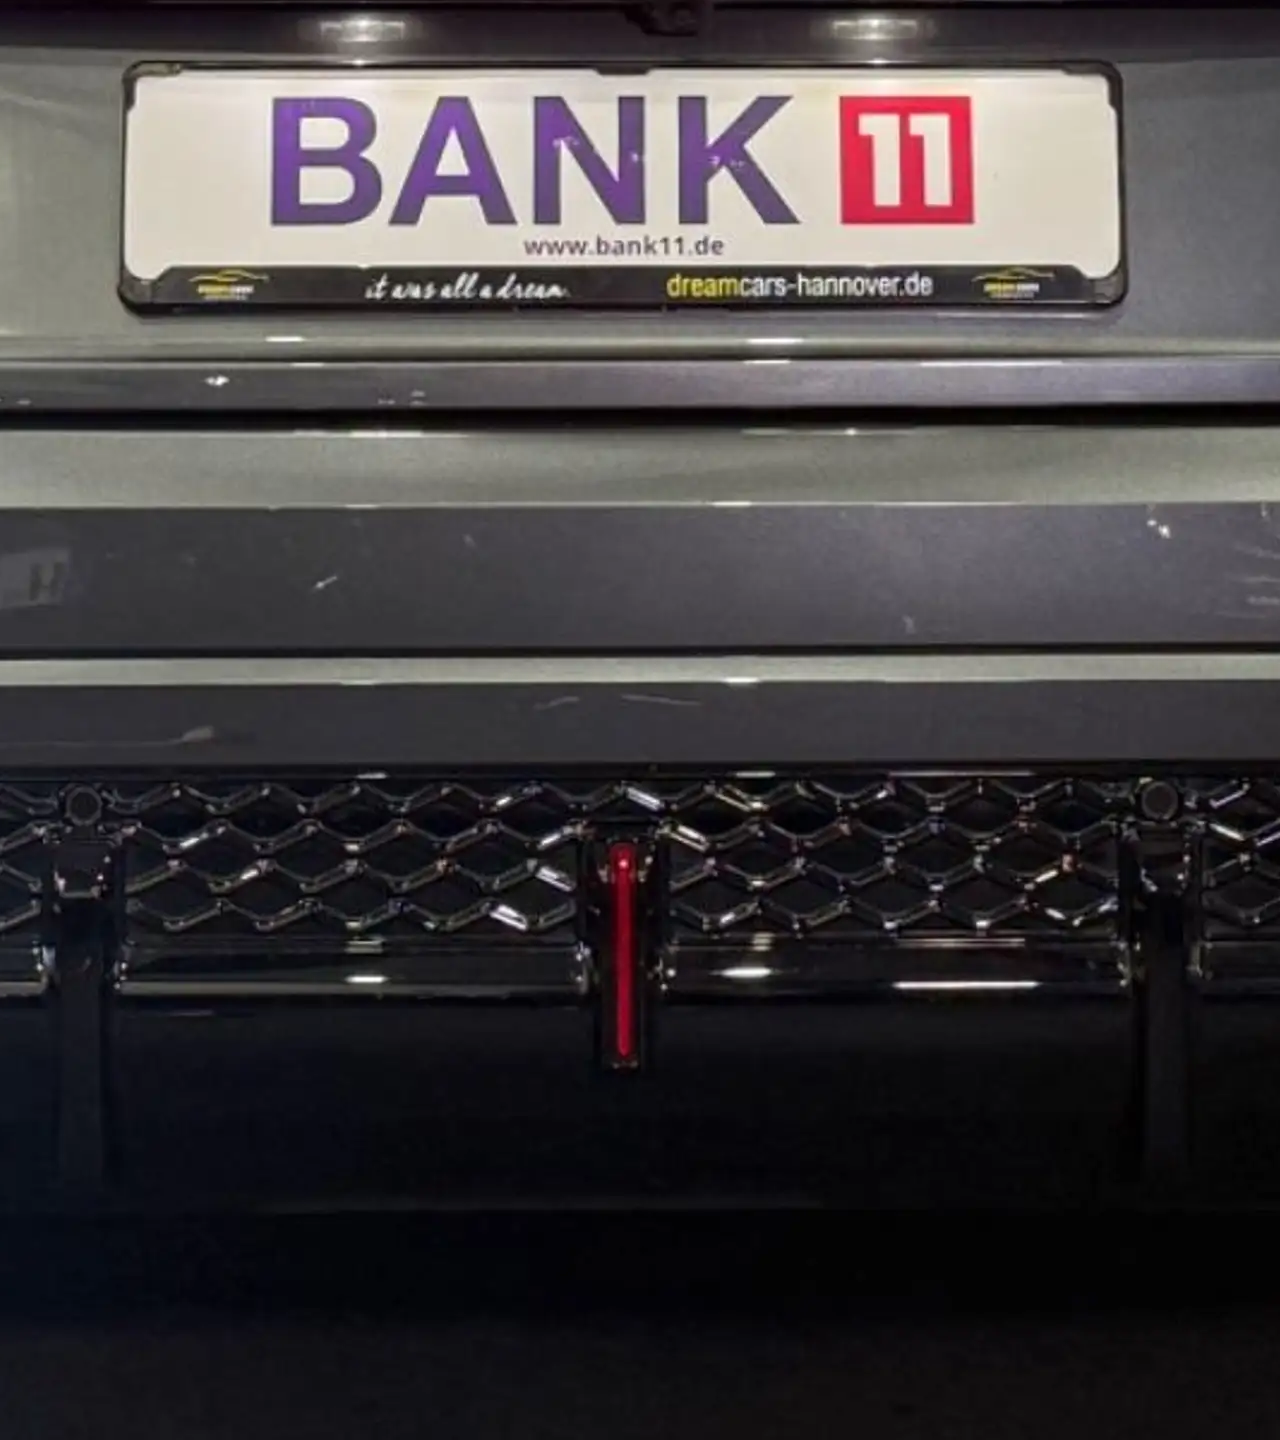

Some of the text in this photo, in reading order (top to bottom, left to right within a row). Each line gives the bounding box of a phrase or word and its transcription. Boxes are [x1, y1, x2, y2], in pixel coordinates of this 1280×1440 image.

[270, 95, 960, 226] BANK 11
[523, 234, 725, 257] www.bank11.de
[364, 272, 568, 300] it was all a dream
[666, 271, 933, 298] dreamcars-hannover.de
